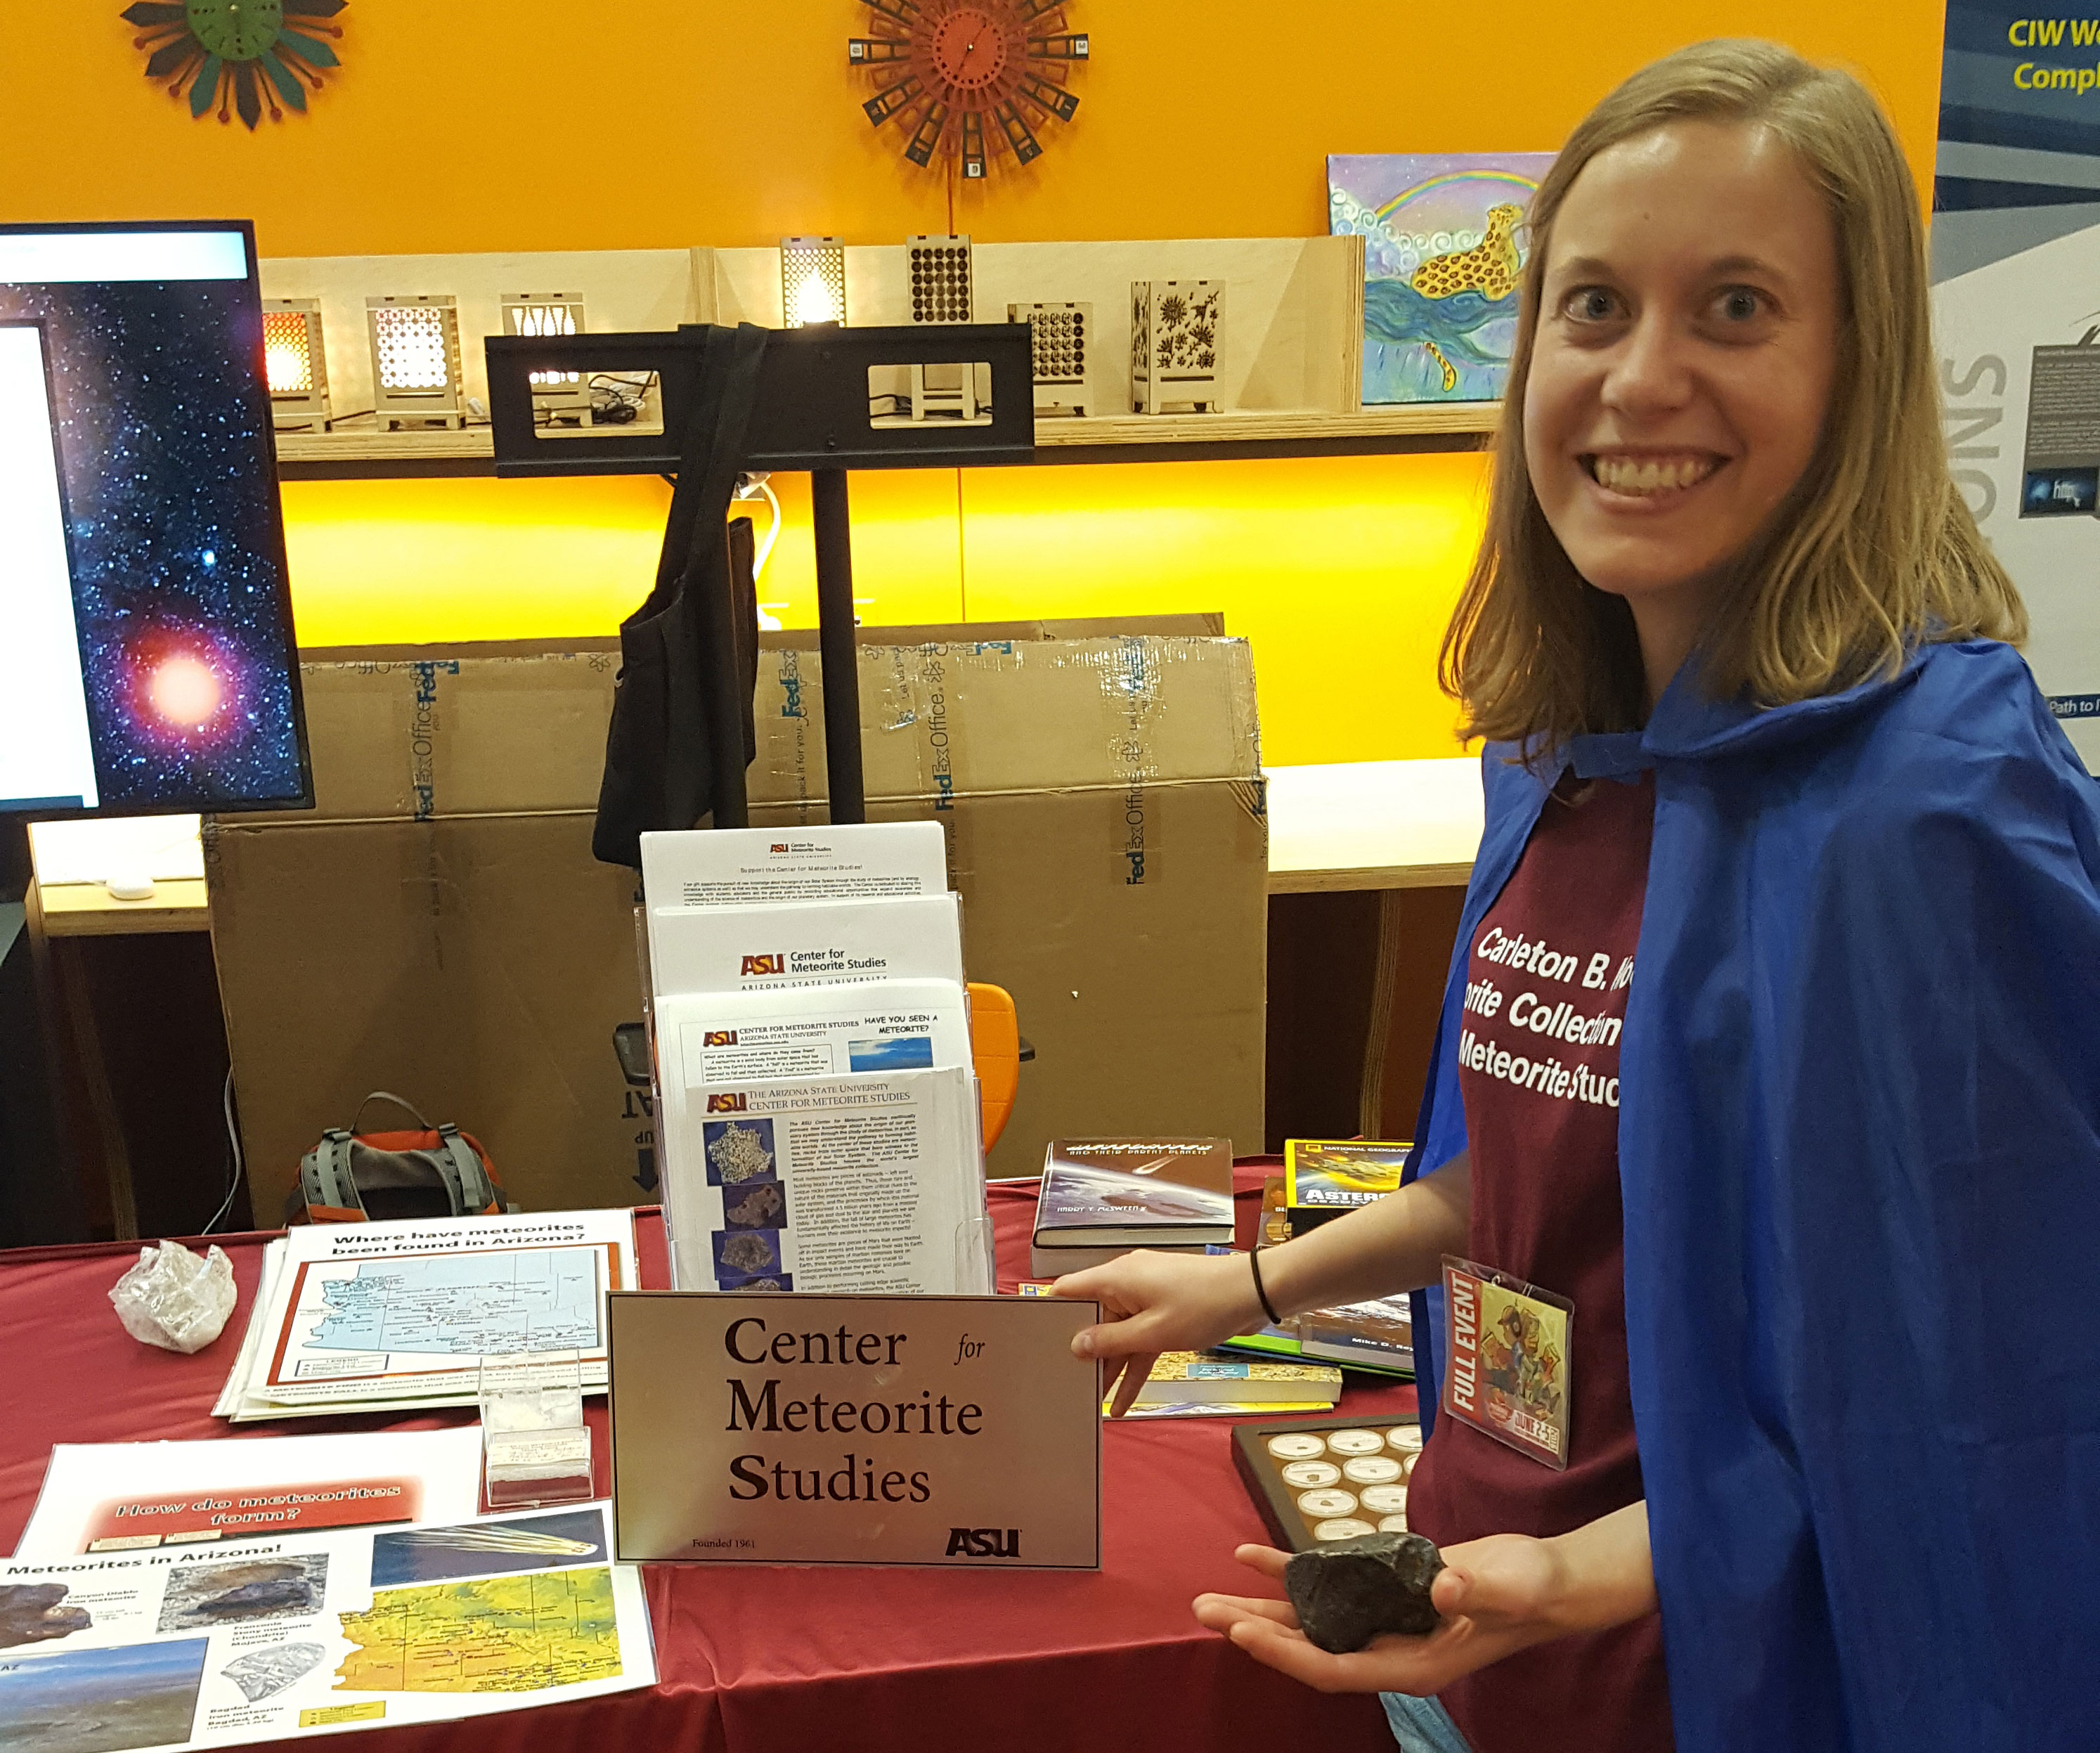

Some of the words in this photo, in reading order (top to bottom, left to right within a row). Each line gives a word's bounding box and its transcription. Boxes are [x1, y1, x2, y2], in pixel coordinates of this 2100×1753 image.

[2009, 20, 2066, 47] CIW
[779, 651, 801, 717] FedEx
[2049, 699, 2077, 713] Path
[2080, 701, 2094, 712] to
[412, 701, 433, 757] Office
[796, 751, 805, 765] for
[933, 749, 954, 811] FedEx
[1126, 772, 1143, 825] Office
[770, 843, 789, 853] ASU
[1126, 825, 1145, 885] FedEx
[741, 953, 786, 976] ASU
[791, 951, 826, 962] Center
[829, 949, 845, 959] for
[791, 960, 845, 973] Meteorite
[848, 958, 887, 969] Studies
[1477, 927, 1578, 983] Carleton
[1582, 952, 1610, 990] B.
[741, 983, 786, 991] ARIZONA
[864, 1016, 886, 1025] HAVE
[879, 1026, 929, 1035] METEORITE?
[703, 1030, 738, 1047] ASU
[1458, 1029, 1570, 1098] Meteorite
[706, 1092, 748, 1113] ASU
[748, 1090, 767, 1099] THE
[769, 1088, 808, 1098] ARIZONA
[810, 1086, 837, 1095] STATE
[839, 1083, 889, 1093] UNIVERSITY
[749, 1101, 789, 1111] CENTER
[790, 1099, 810, 1108] FOR
[812, 1095, 868, 1107] METEORITE
[870, 1092, 911, 1103] STUDIES
[332, 1245, 387, 1255] been
[394, 1241, 458, 1250] found
[465, 1238, 485, 1247] in
[491, 1234, 586, 1246] Arizona?
[334, 1234, 406, 1244] Where
[411, 1230, 463, 1240] have
[469, 1224, 585, 1236] meteorites
[1451, 1273, 1476, 1351] EVENT
[725, 1317, 907, 1365] Center
[954, 1333, 985, 1366] for
[1453, 1356, 1476, 1412] FULL
[725, 1378, 983, 1435] Meteorite
[729, 1454, 931, 1503] Studies
[115, 1503, 186, 1518] How
[192, 1498, 233, 1512] do
[239, 1485, 401, 1508] meteorites
[210, 1508, 301, 1525] form?
[692, 1538, 732, 1548] Founded
[735, 1539, 755, 1548] 1961
[945, 1527, 1022, 1558] ASU
[7, 1559, 143, 1575] Meteorites
[150, 1555, 171, 1565] in
[179, 1544, 282, 1562] Arizona!
